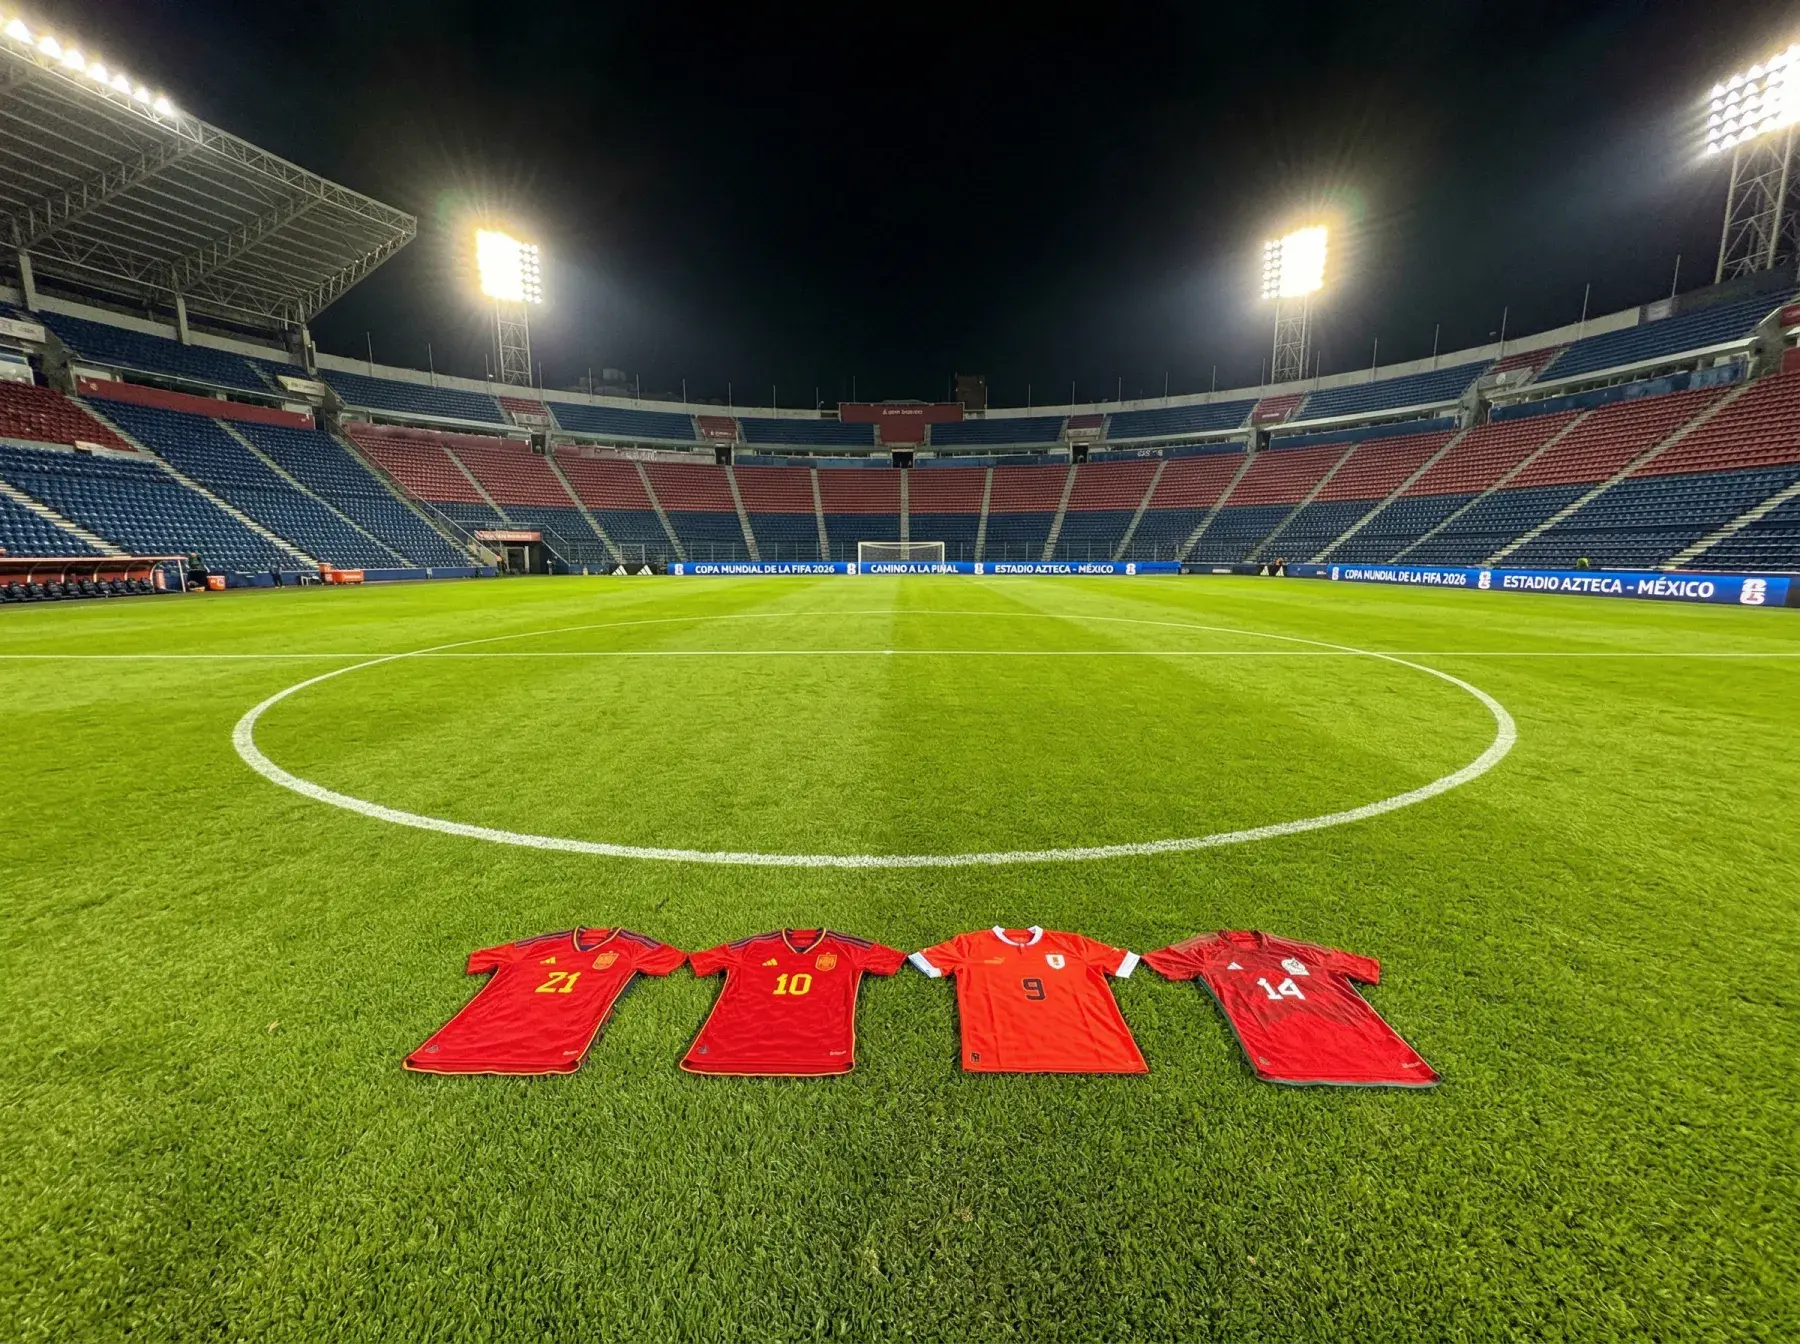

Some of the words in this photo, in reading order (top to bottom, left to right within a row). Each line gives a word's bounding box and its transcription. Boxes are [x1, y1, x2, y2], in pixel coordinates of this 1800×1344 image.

[695, 565, 720, 574] COPA
[721, 564, 764, 574] MUNDIAL
[764, 565, 777, 574] DE
[778, 564, 791, 574] LA
[791, 564, 812, 574] FIFA
[812, 564, 835, 574] 2026
[908, 564, 916, 574] A
[917, 564, 930, 574] LA
[994, 564, 1034, 574] ESTADIO
[1034, 564, 1071, 574] AZTECA
[1078, 562, 1114, 574] MÉXICO
[1345, 569, 1363, 580] COPA
[1398, 571, 1410, 582] DE
[1410, 571, 1421, 583] LA
[1422, 572, 1441, 584] FIFA
[1442, 573, 1467, 586] 2026
[1502, 575, 1559, 590] ESTADIO
[1560, 578, 1622, 594] AZTECA
[1637, 577, 1715, 598] MÉXICO
[535, 971, 582, 994] 21
[772, 973, 813, 996] 10
[1022, 977, 1047, 1001] 9
[1257, 977, 1306, 1001] 14
